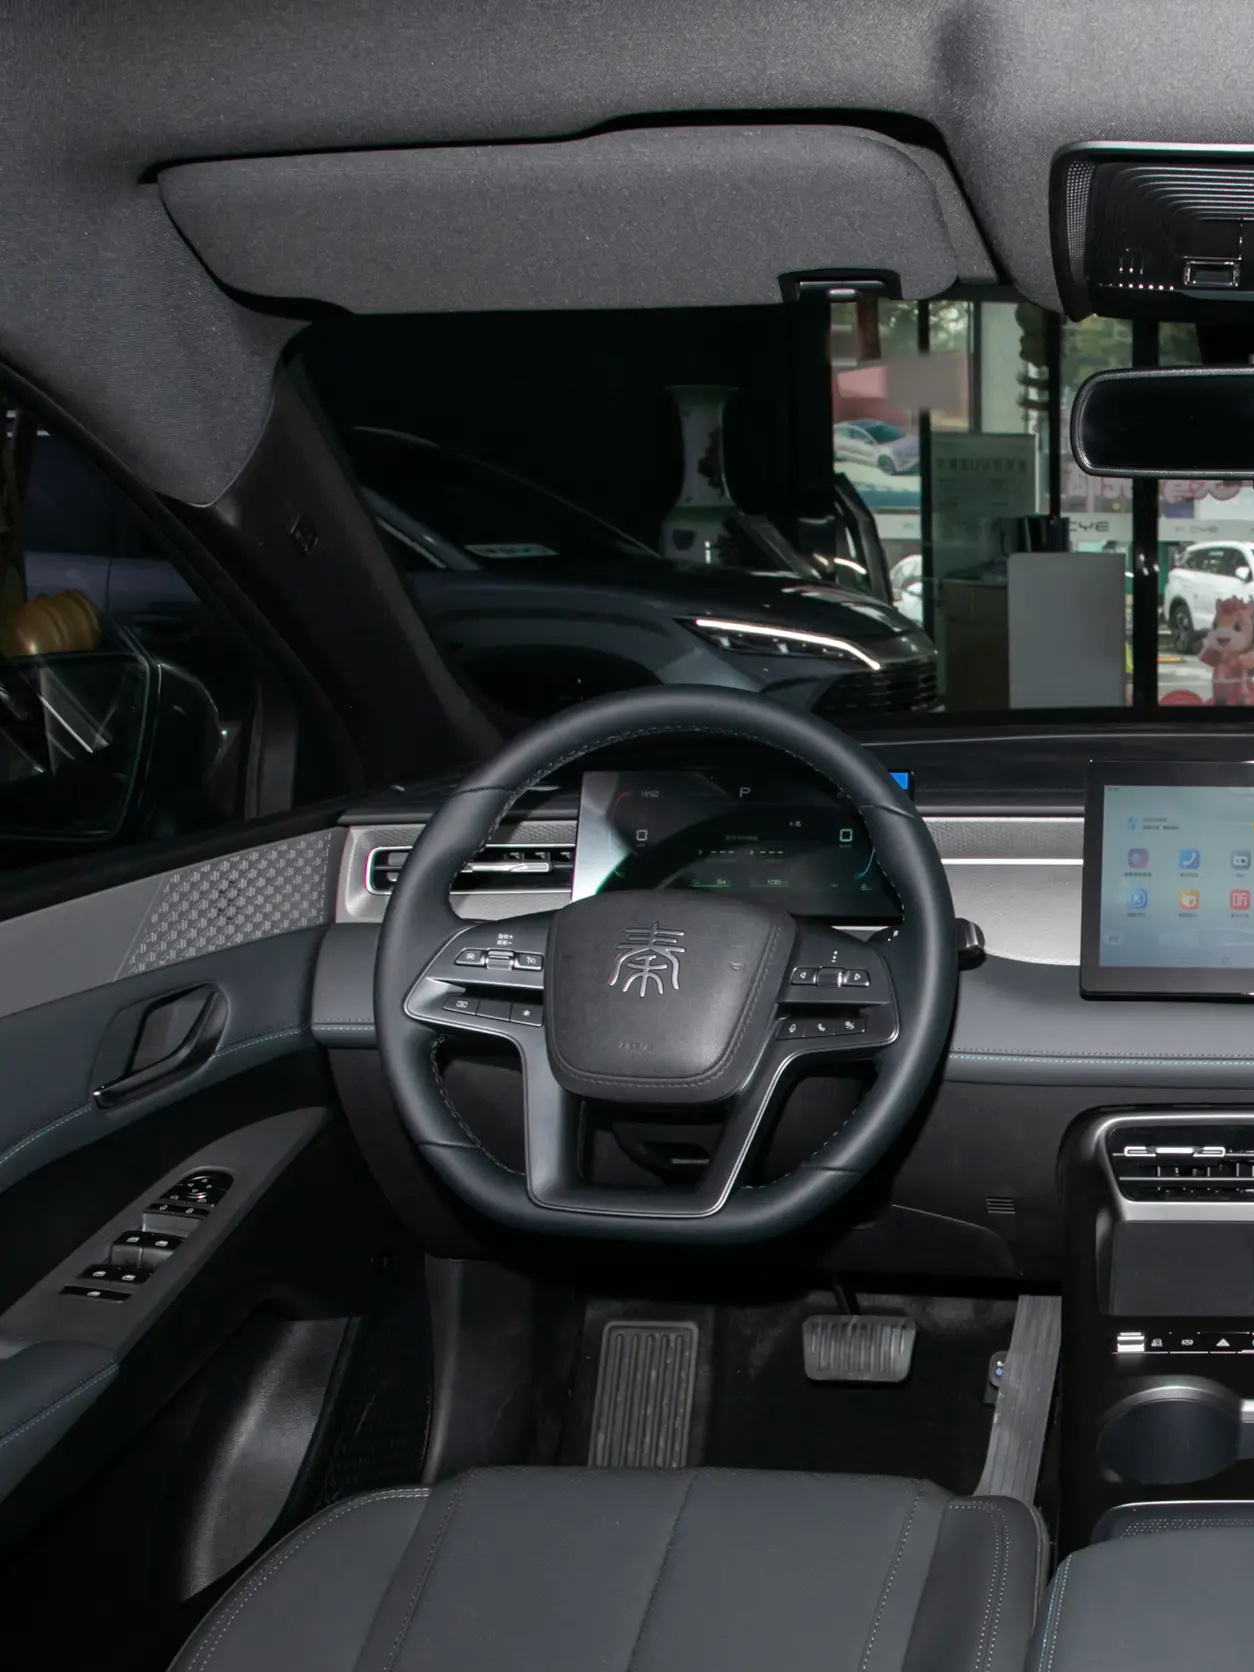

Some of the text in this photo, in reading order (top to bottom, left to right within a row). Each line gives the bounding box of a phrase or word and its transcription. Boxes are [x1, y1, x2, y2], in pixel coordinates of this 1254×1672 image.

[739, 787, 751, 798] P
[636, 829, 648, 841] 0
[839, 828, 853, 842] 0
[607, 921, 686, 998] 秦
